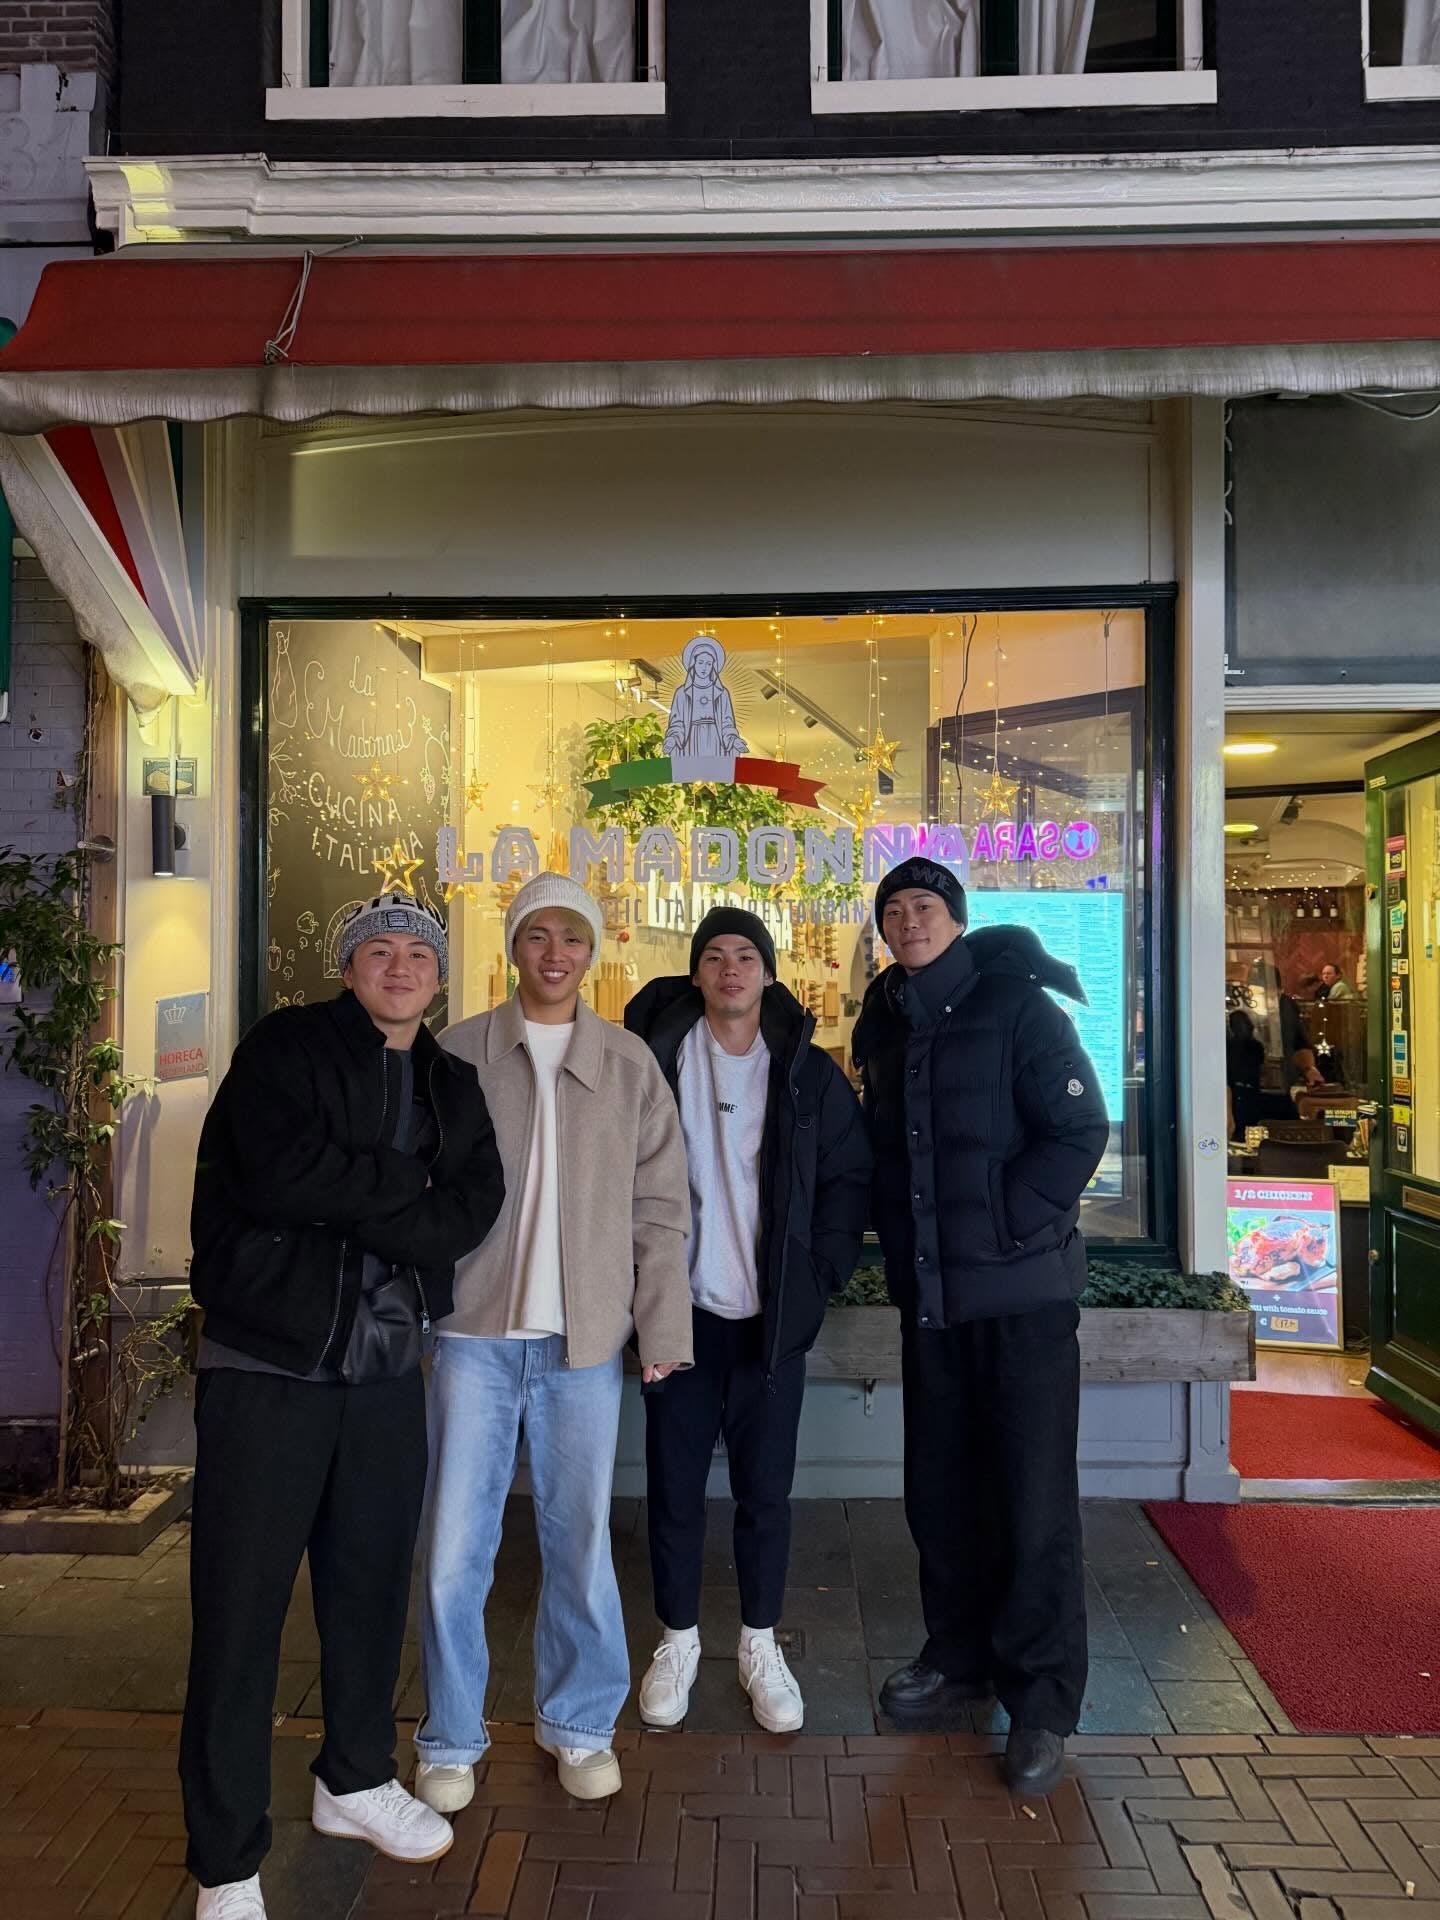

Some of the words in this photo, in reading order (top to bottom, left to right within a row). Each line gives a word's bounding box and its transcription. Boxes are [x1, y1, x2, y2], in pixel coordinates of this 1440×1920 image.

[350, 656, 376, 697] La
[308, 772, 402, 828] CUCINA
[311, 826, 424, 875] ITALIANA
[439, 827, 539, 883] LA
[570, 826, 970, 885] MADONNA
[159, 1047, 204, 1065] HORECA
[1262, 1304, 1279, 1313] with
[1280, 1305, 1306, 1315] tomato
